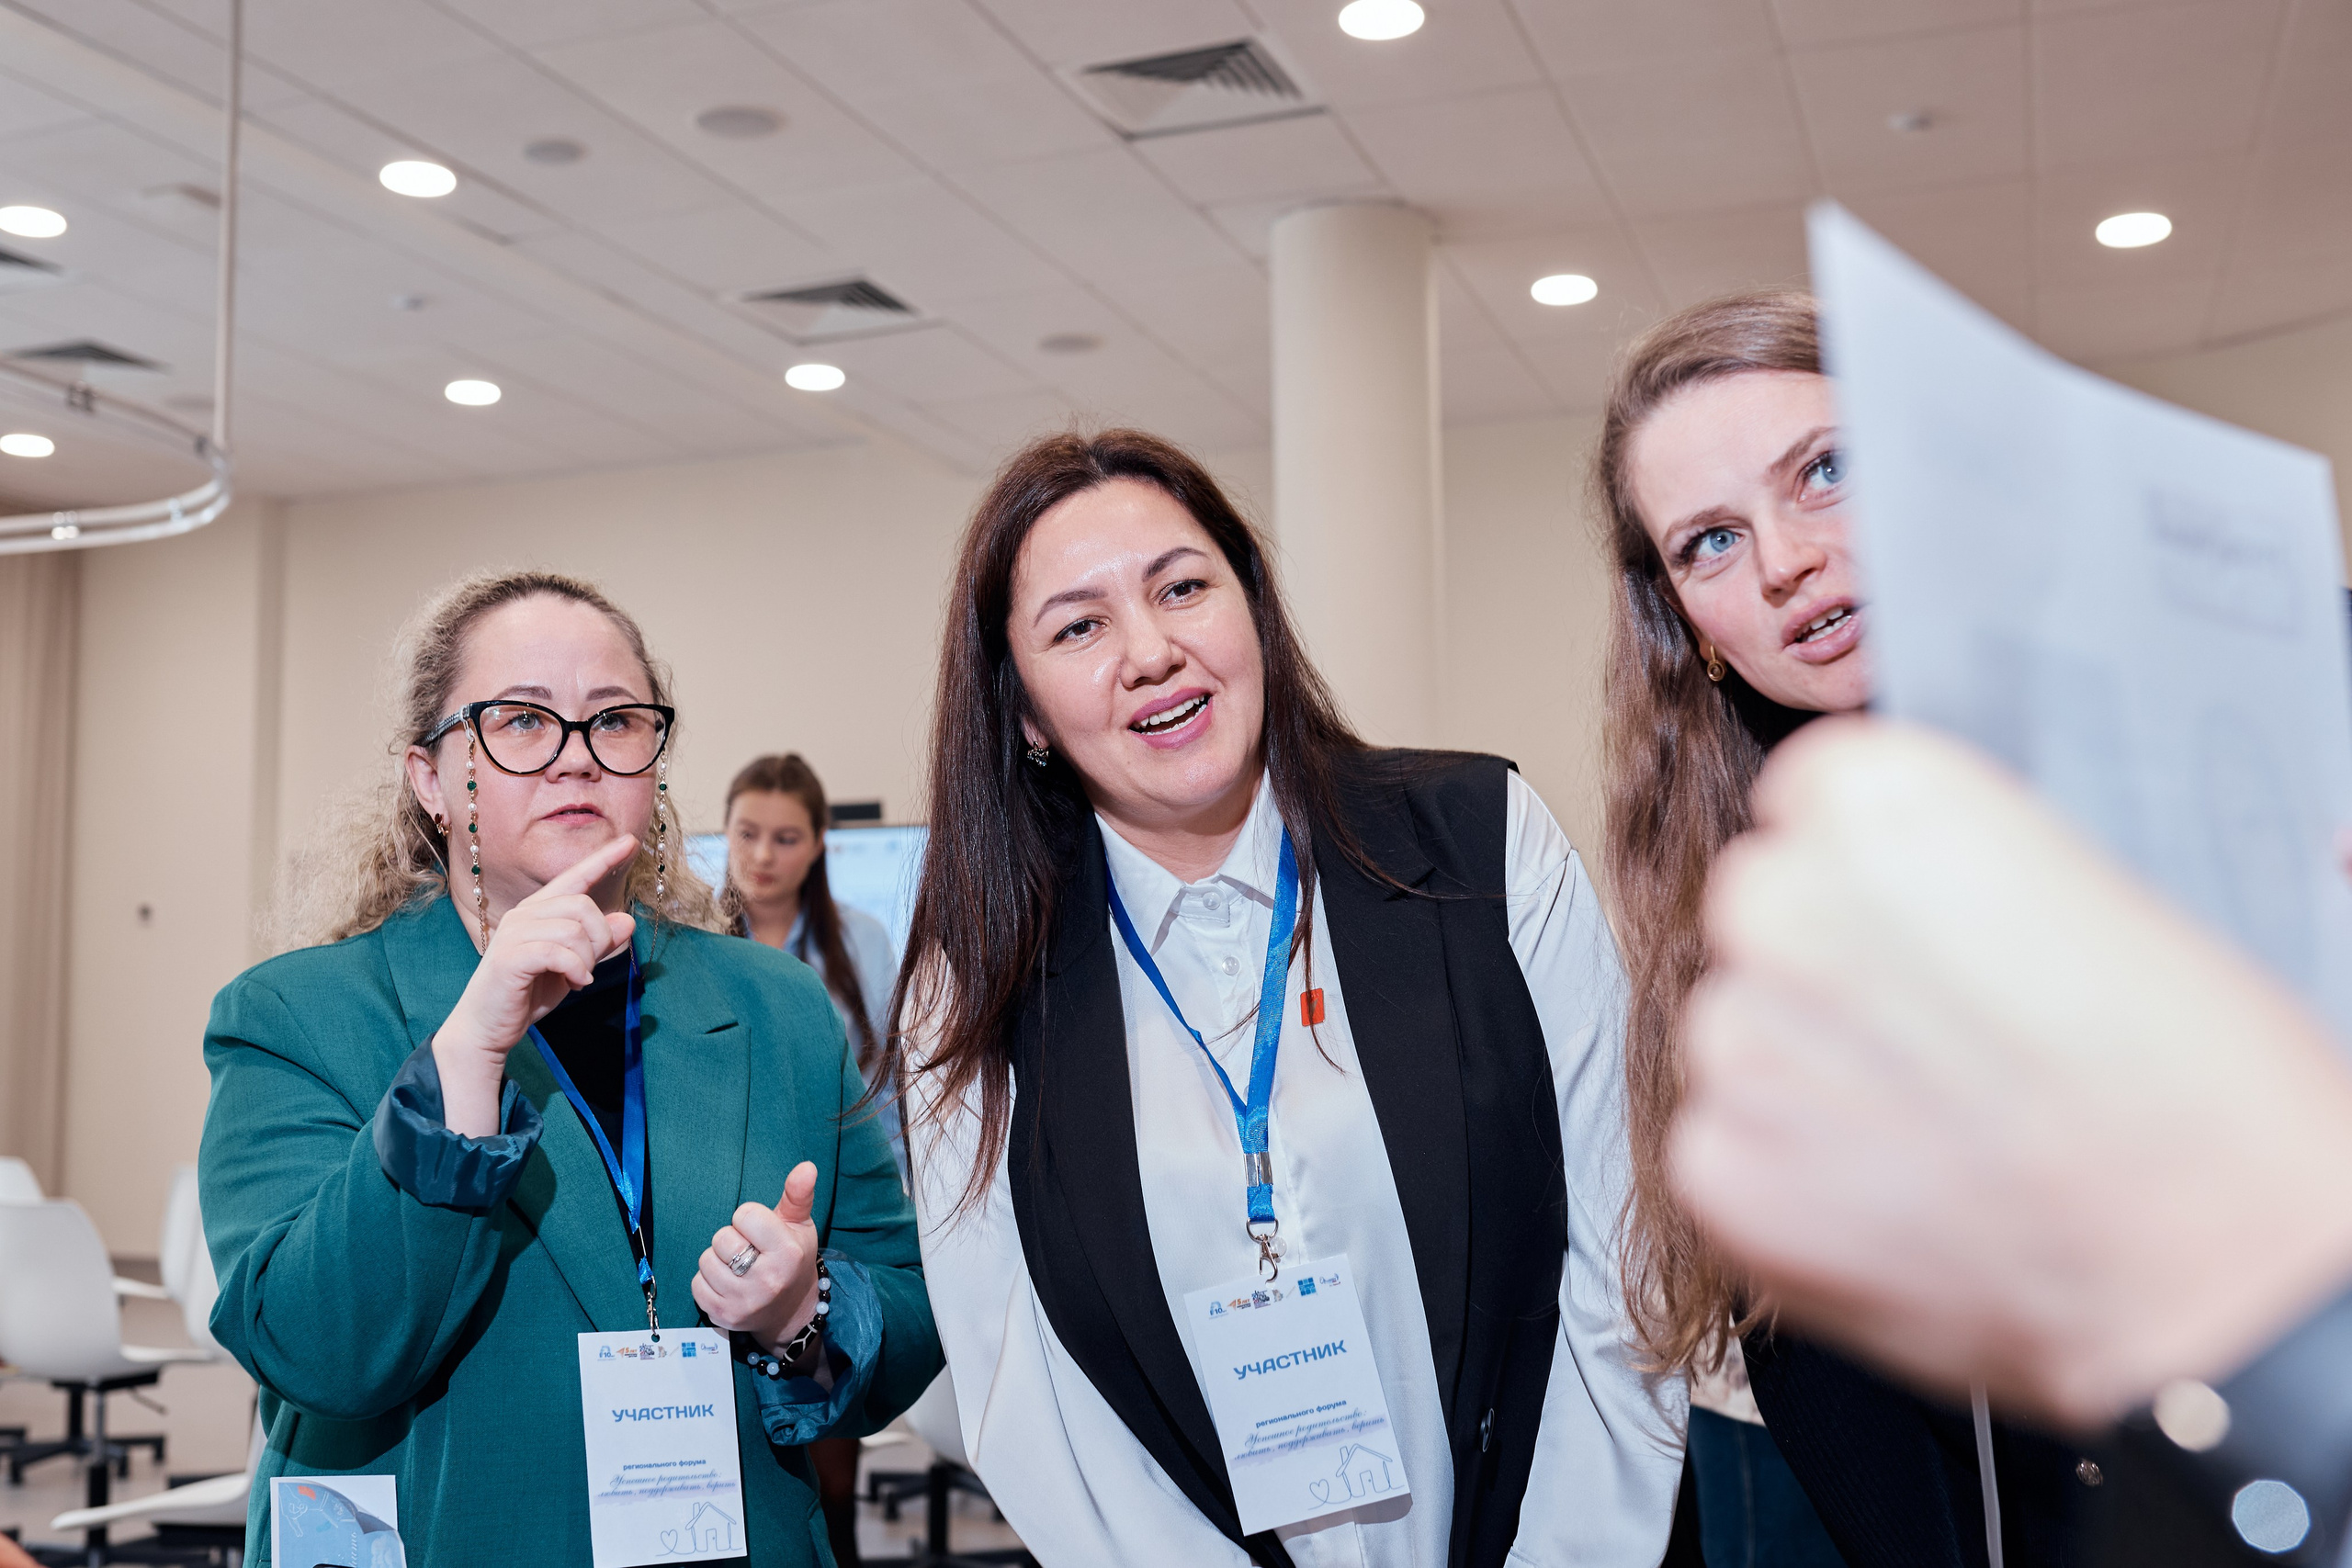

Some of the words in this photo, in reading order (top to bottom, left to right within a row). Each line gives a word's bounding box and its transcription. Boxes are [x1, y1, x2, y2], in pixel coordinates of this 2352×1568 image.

[1233, 1339, 1347, 1380] УЧАСТНИК
[612, 1404, 714, 1422] УЧАСТНИК
[1255, 1407, 1314, 1428] регионального
[1316, 1399, 1347, 1413] форума
[1351, 1417, 1385, 1434] верить
[1245, 1429, 1294, 1446] Успешное
[623, 1461, 677, 1471] регионального
[678, 1459, 707, 1467] форума
[610, 1474, 656, 1486] Успешное
[706, 1480, 736, 1491] верить
